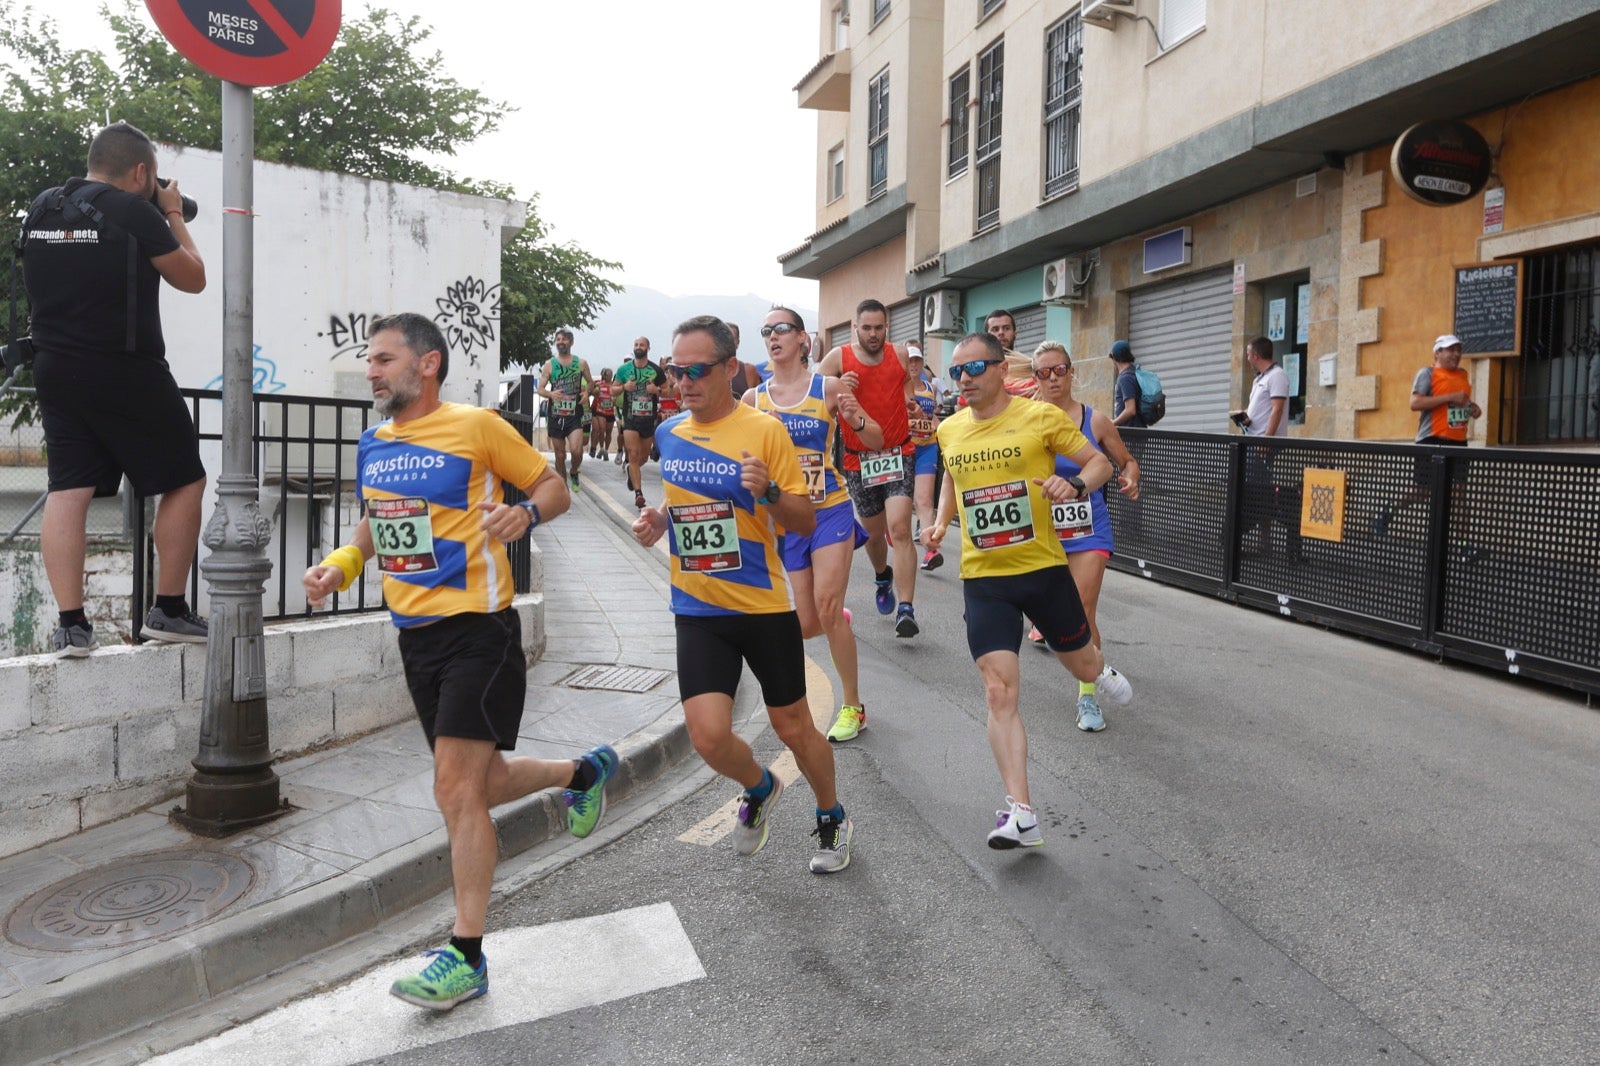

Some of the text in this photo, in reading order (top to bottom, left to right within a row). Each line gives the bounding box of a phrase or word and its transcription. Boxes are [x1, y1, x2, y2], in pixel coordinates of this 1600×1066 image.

[208, 11, 258, 31] MESES
[208, 26, 255, 45] PARES
[366, 453, 445, 479] agustinos
[664, 458, 737, 476] agustinos
[863, 457, 899, 476] 1021
[949, 446, 1022, 469] agustinos
[958, 460, 1010, 474] GRANADA
[671, 474, 722, 485] GRANADA
[974, 502, 1021, 531] 846
[377, 522, 417, 550] 833
[682, 523, 726, 551] 843
